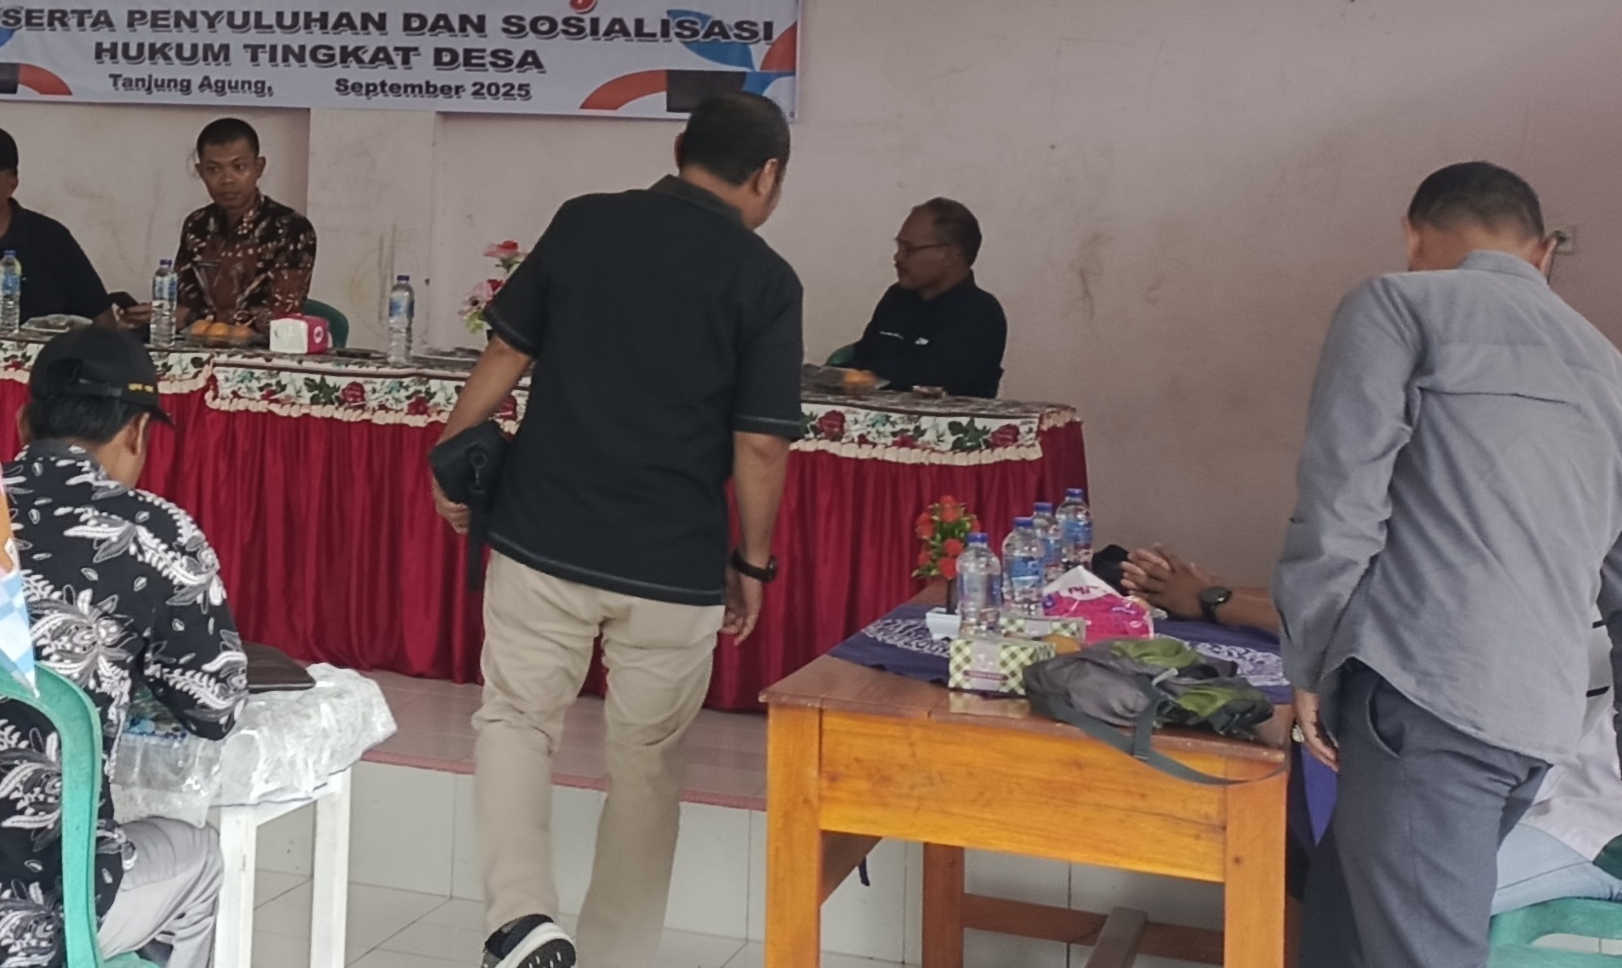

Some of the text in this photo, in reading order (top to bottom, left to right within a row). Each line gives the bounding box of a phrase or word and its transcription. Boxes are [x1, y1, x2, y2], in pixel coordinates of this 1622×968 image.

[126, 9, 389, 35] PENYULUHAN
[401, 12, 489, 37] DAN
[499, 13, 776, 44] SOSIALISASI
[93, 40, 547, 73] HUKUM TINGKAT DESA
[108, 73, 274, 98] Tanjung Agung,
[334, 77, 533, 102] September 2025
